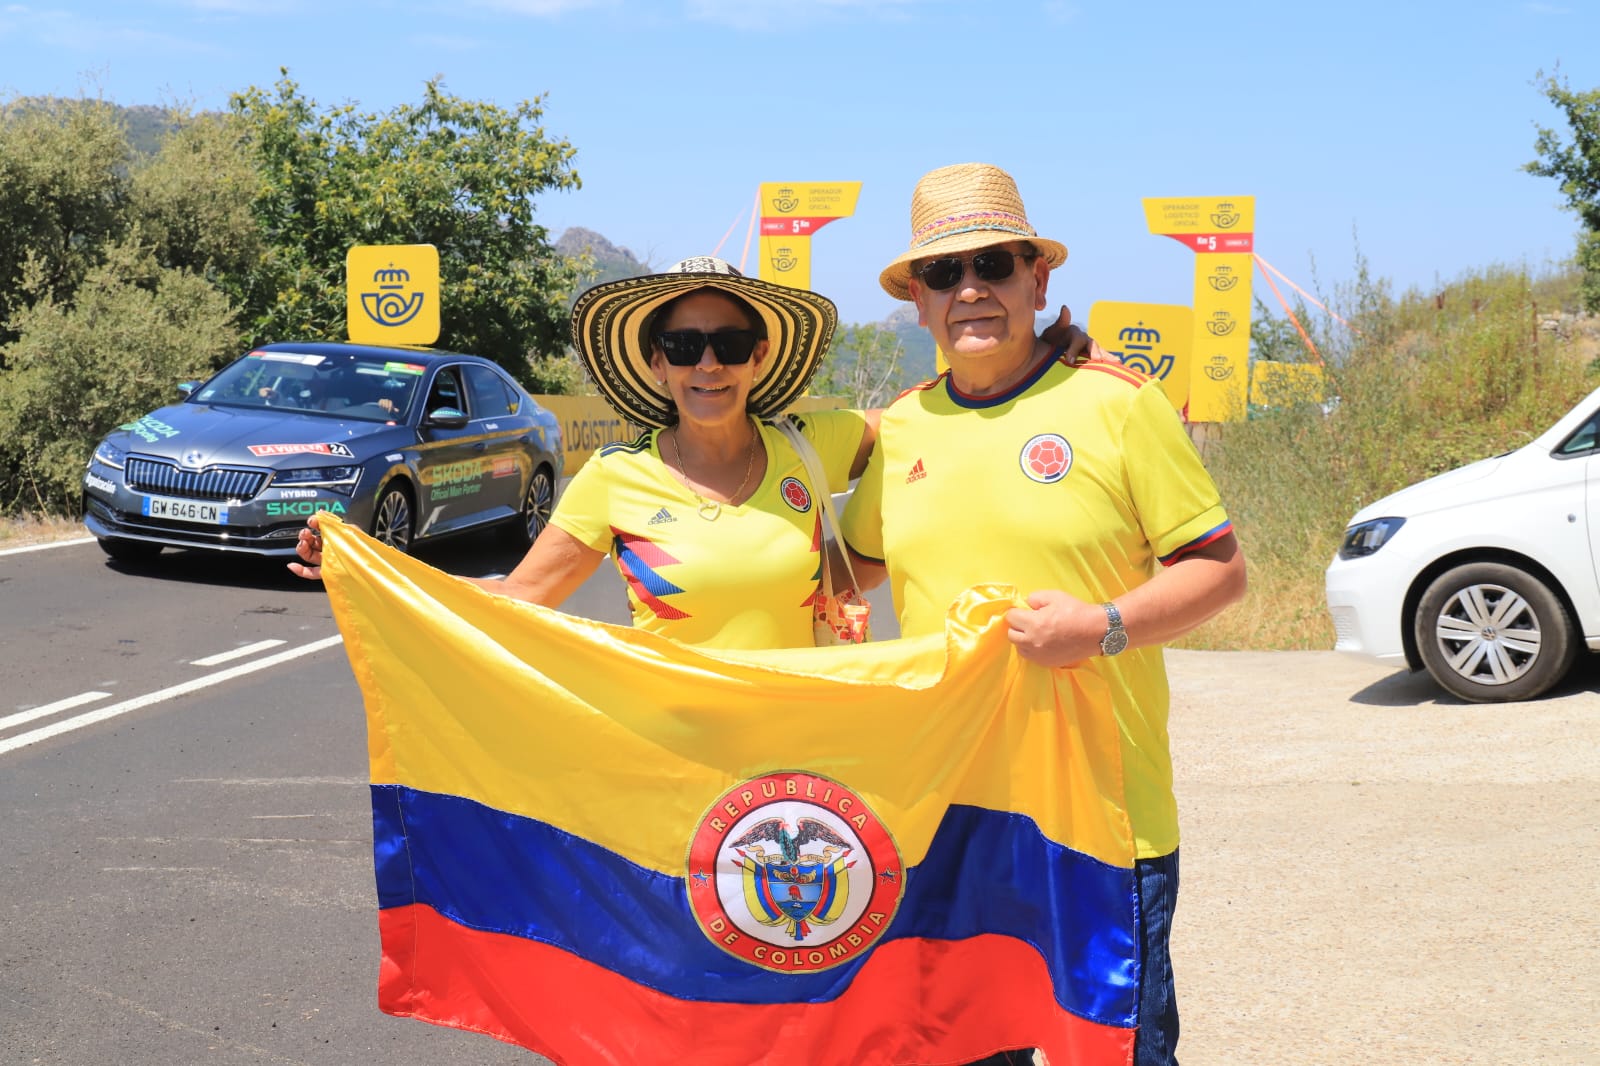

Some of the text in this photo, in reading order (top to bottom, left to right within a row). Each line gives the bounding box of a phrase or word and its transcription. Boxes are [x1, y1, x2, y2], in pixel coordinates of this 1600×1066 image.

[792, 220, 800, 233] 5
[1208, 236, 1217, 250] 5
[330, 444, 346, 455] 24
[280, 490, 318, 499] HYBRID
[266, 501, 346, 516] SKODA
[709, 779, 869, 833] REPUBLICA
[709, 911, 886, 966] DE COLOMBIA
